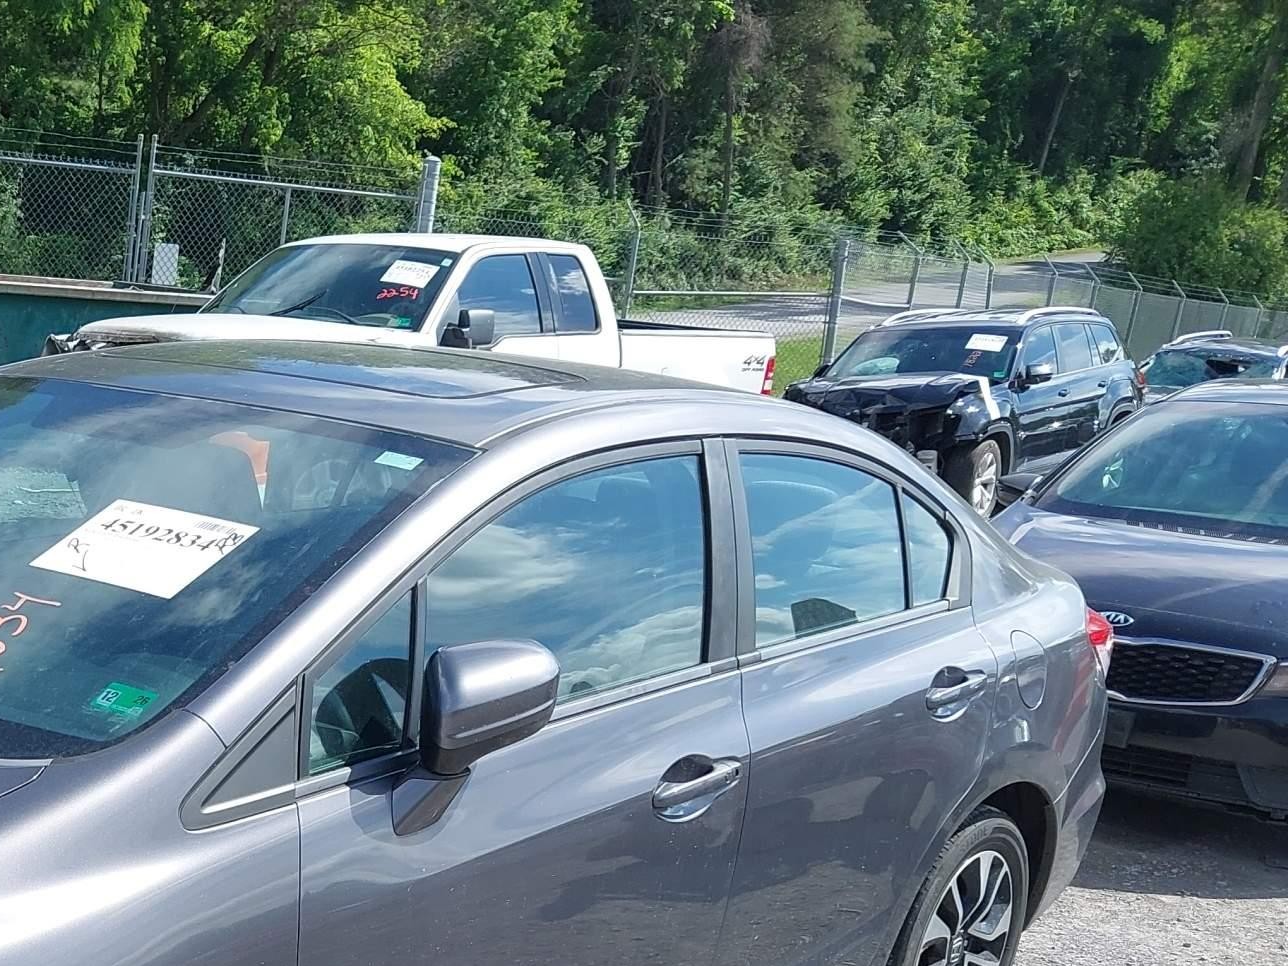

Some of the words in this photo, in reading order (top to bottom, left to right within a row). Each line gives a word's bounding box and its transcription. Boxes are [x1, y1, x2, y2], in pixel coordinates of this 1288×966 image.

[376, 287, 419, 300] 2254
[100, 518, 219, 552] 45192834
[101, 690, 119, 703] 12
